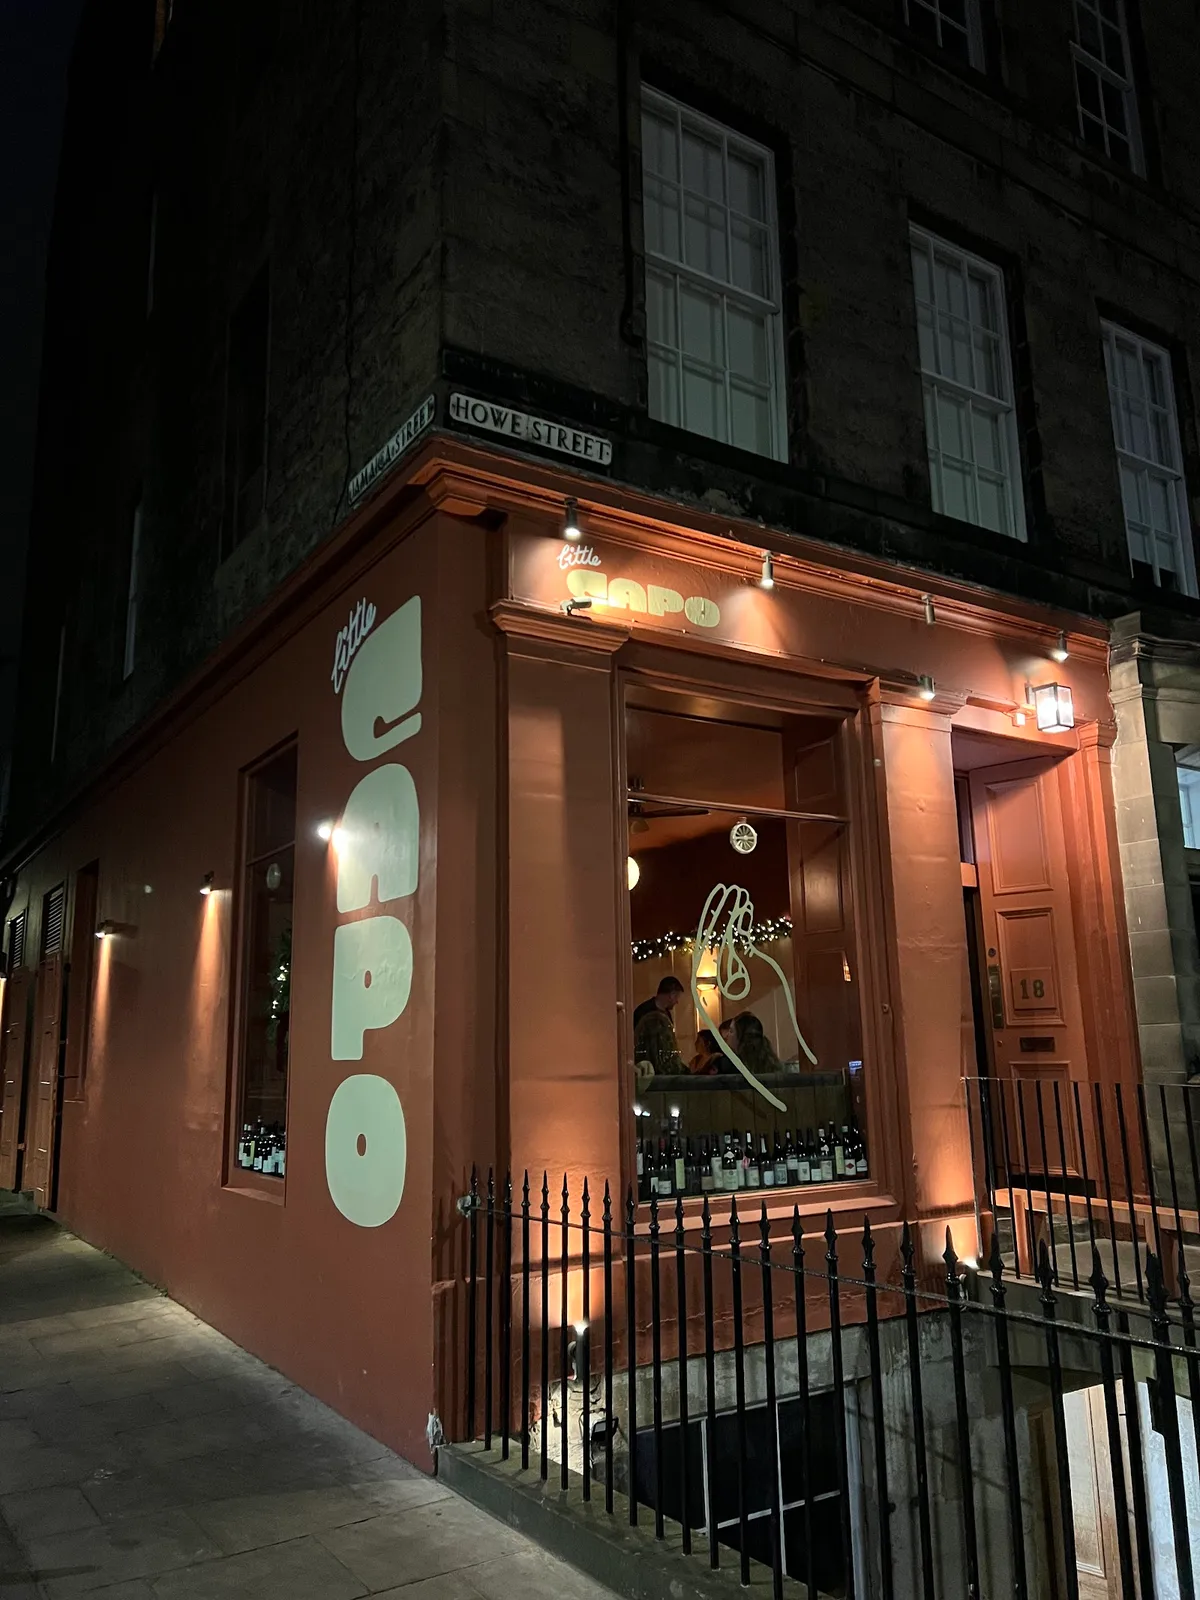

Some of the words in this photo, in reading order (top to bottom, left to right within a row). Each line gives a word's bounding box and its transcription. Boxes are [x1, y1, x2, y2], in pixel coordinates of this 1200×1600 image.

[350, 444, 391, 498] JAMAICA
[395, 398, 433, 453] STREET
[455, 396, 522, 436] HOWE
[531, 420, 612, 461] STREET
[1019, 978, 1045, 1000] 18
